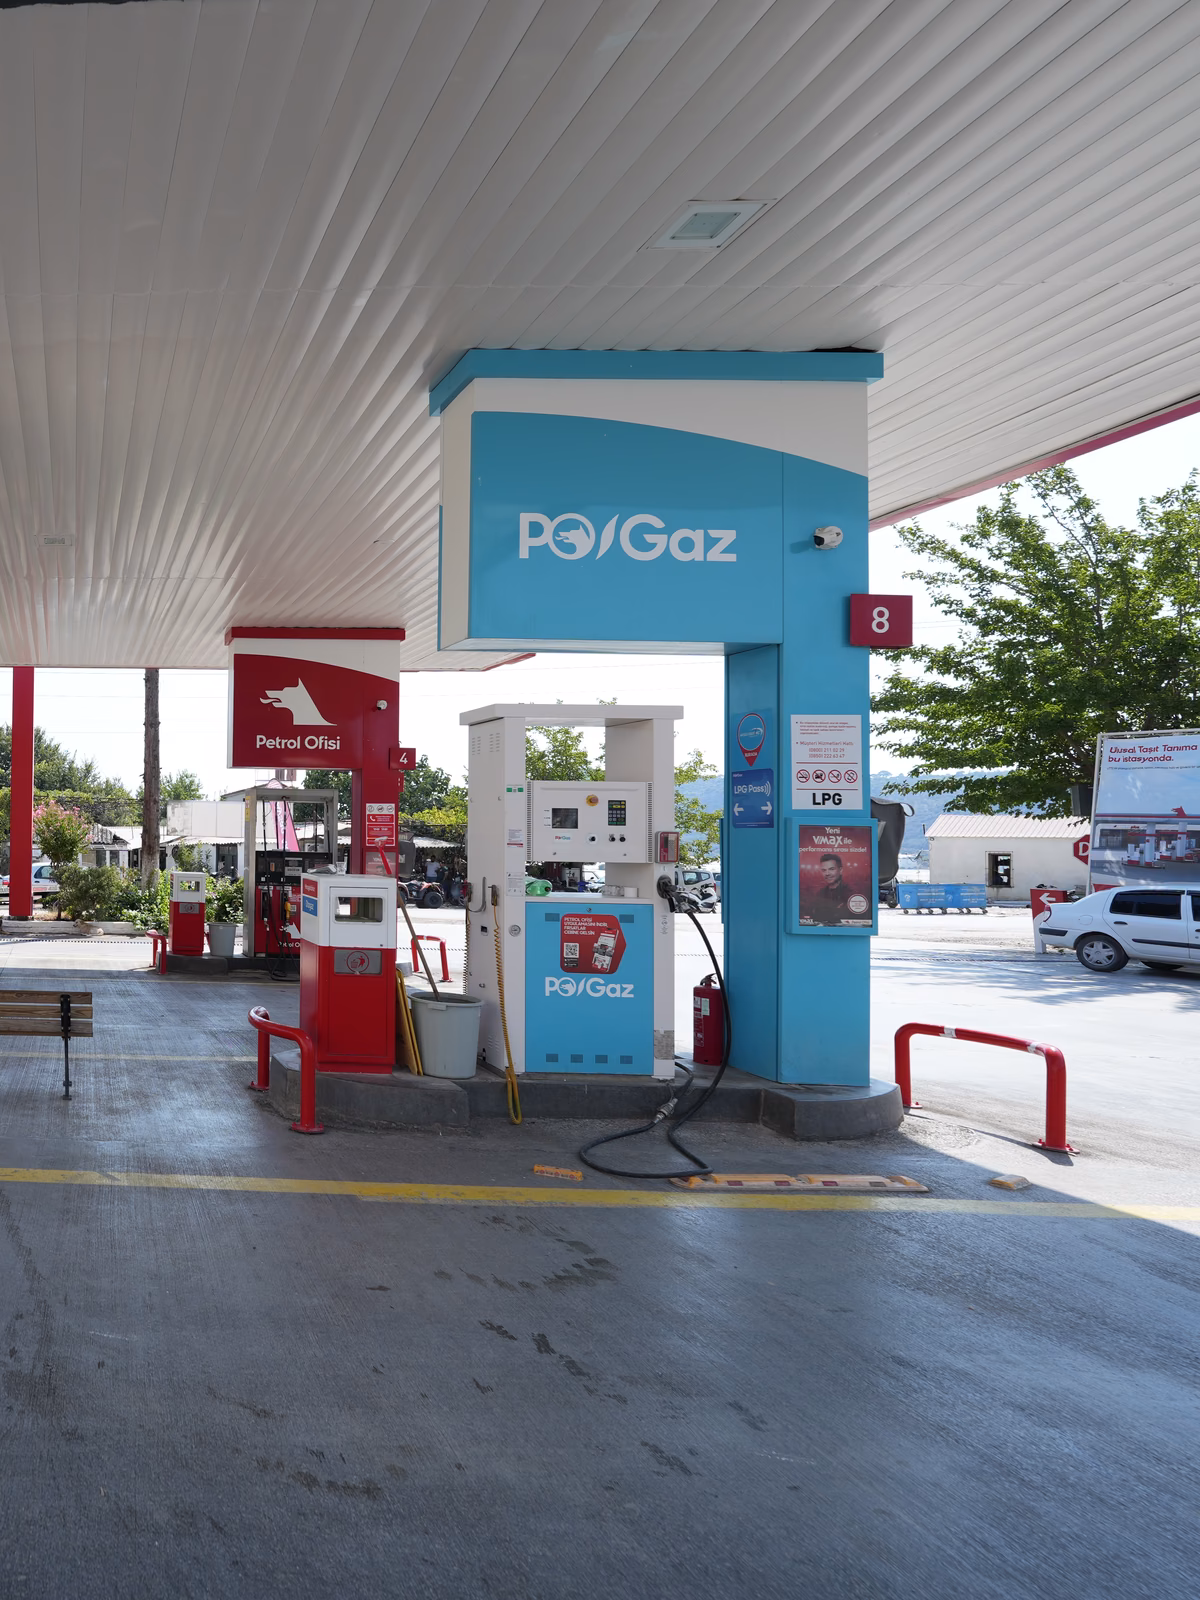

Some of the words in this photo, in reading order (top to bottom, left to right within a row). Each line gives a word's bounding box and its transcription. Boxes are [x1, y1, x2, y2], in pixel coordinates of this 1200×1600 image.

[871, 606, 890, 634] 8
[256, 734, 300, 749] Petrol
[304, 735, 341, 750] Ofisi
[1109, 746, 1136, 754] Ulusal
[1137, 745, 1159, 754] Taşıt
[1162, 744, 1198, 752] Tanıma
[399, 752, 408, 764] 4
[1107, 755, 1121, 763] bu
[1122, 754, 1174, 764] istasyonda.
[734, 785, 748, 794] LPG
[748, 784, 765, 793] Pass
[812, 792, 843, 806] LPG
[824, 826, 841, 834] Yeni
